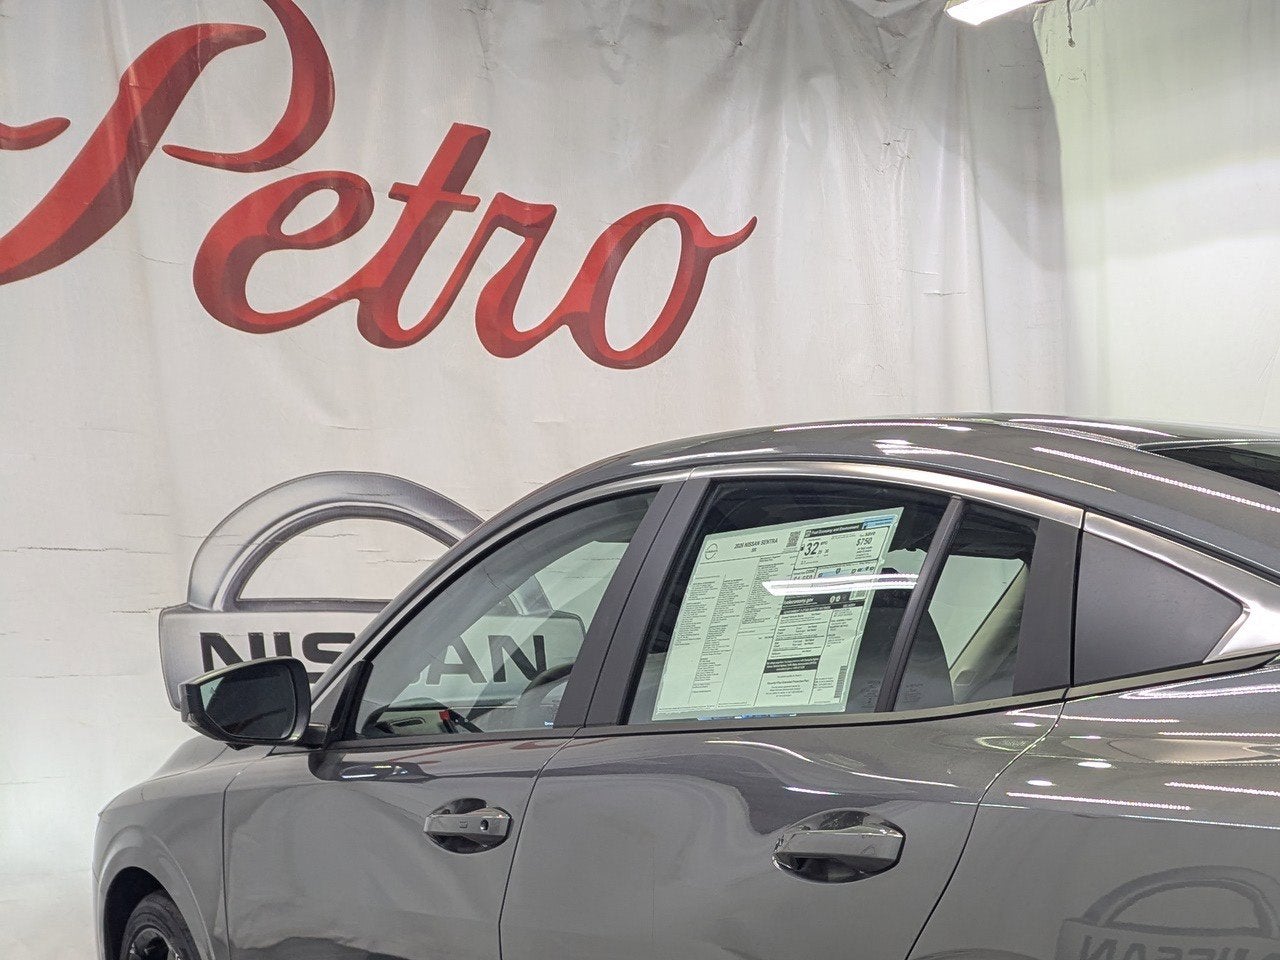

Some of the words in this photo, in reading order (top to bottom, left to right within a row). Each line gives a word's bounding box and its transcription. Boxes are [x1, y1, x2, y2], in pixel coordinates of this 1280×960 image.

[0, 0, 758, 370] Petro
[804, 541, 819, 556] 32
[856, 537, 873, 547] $750
[200, 632, 547, 685] NISAN
